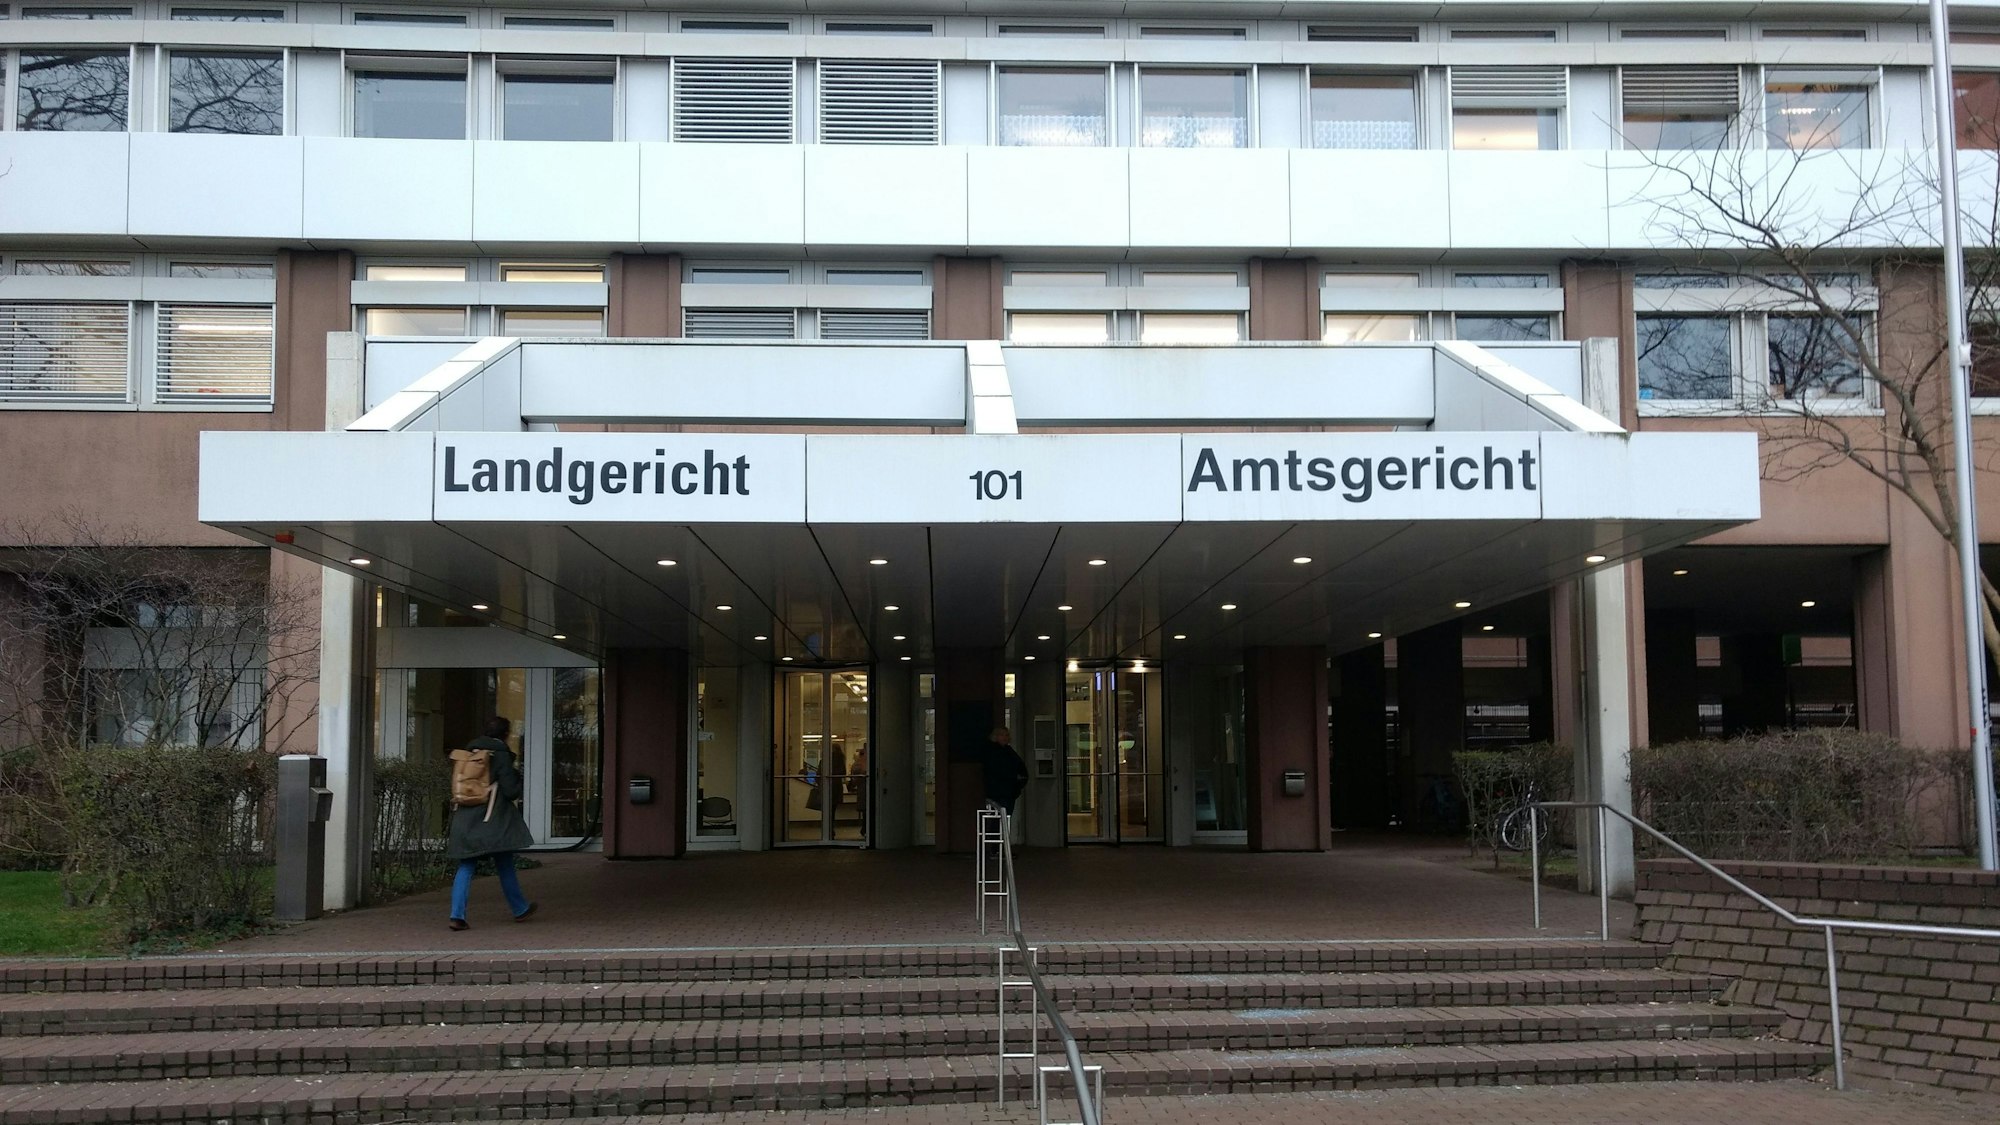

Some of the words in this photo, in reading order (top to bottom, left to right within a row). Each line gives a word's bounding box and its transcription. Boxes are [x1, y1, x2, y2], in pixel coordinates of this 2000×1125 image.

[444, 446, 750, 505] Landgericht
[969, 469, 1022, 501] 101
[1187, 446, 1537, 503] Amtsgericht
